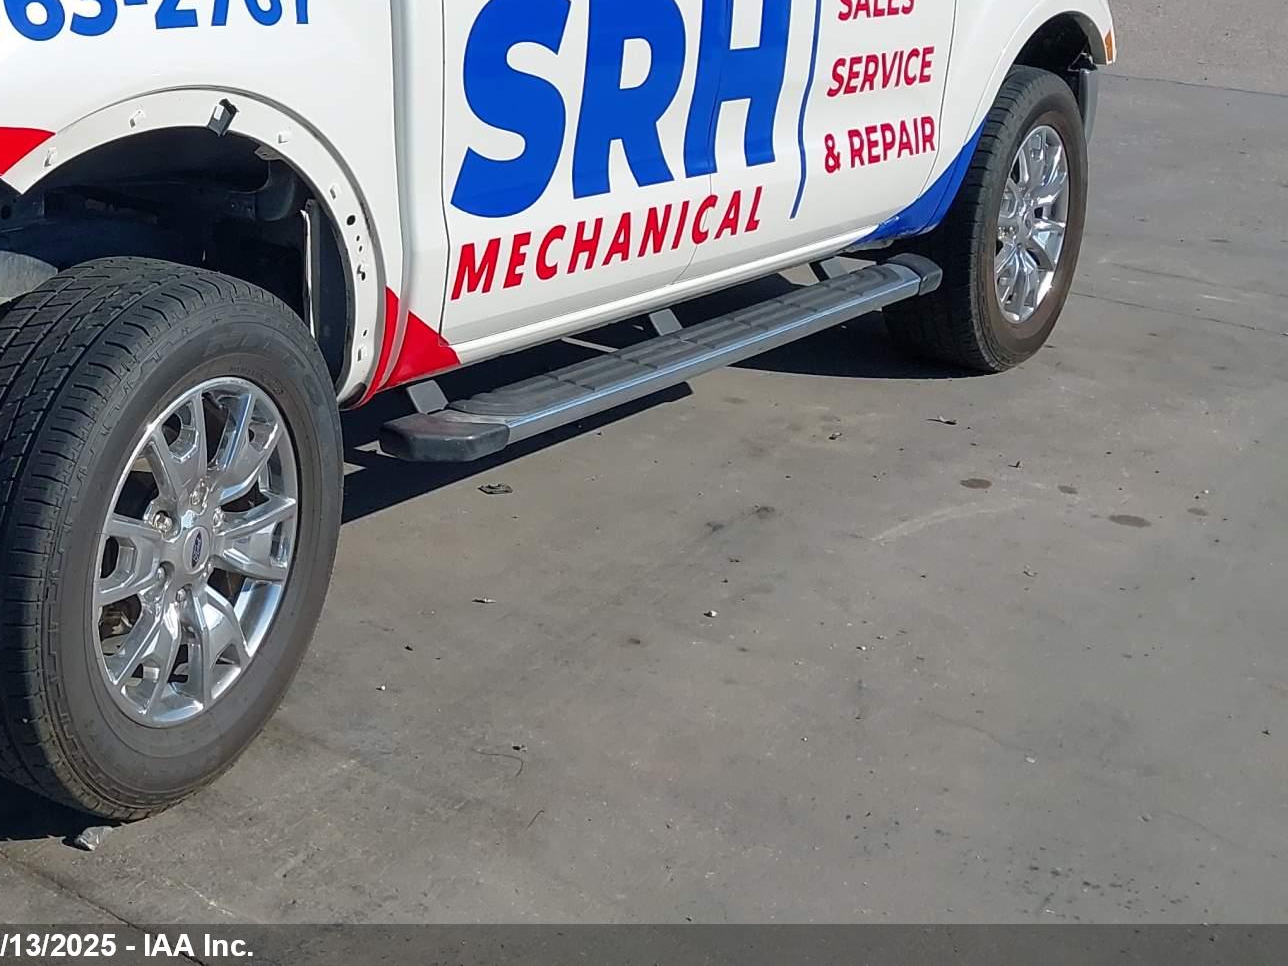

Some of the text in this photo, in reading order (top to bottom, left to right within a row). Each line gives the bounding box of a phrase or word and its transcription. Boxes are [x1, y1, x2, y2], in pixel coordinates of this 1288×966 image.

[827, 47, 935, 97] SERVICE
[824, 116, 936, 174] & REPAIR
[450, 186, 762, 301] MECHANICAL
